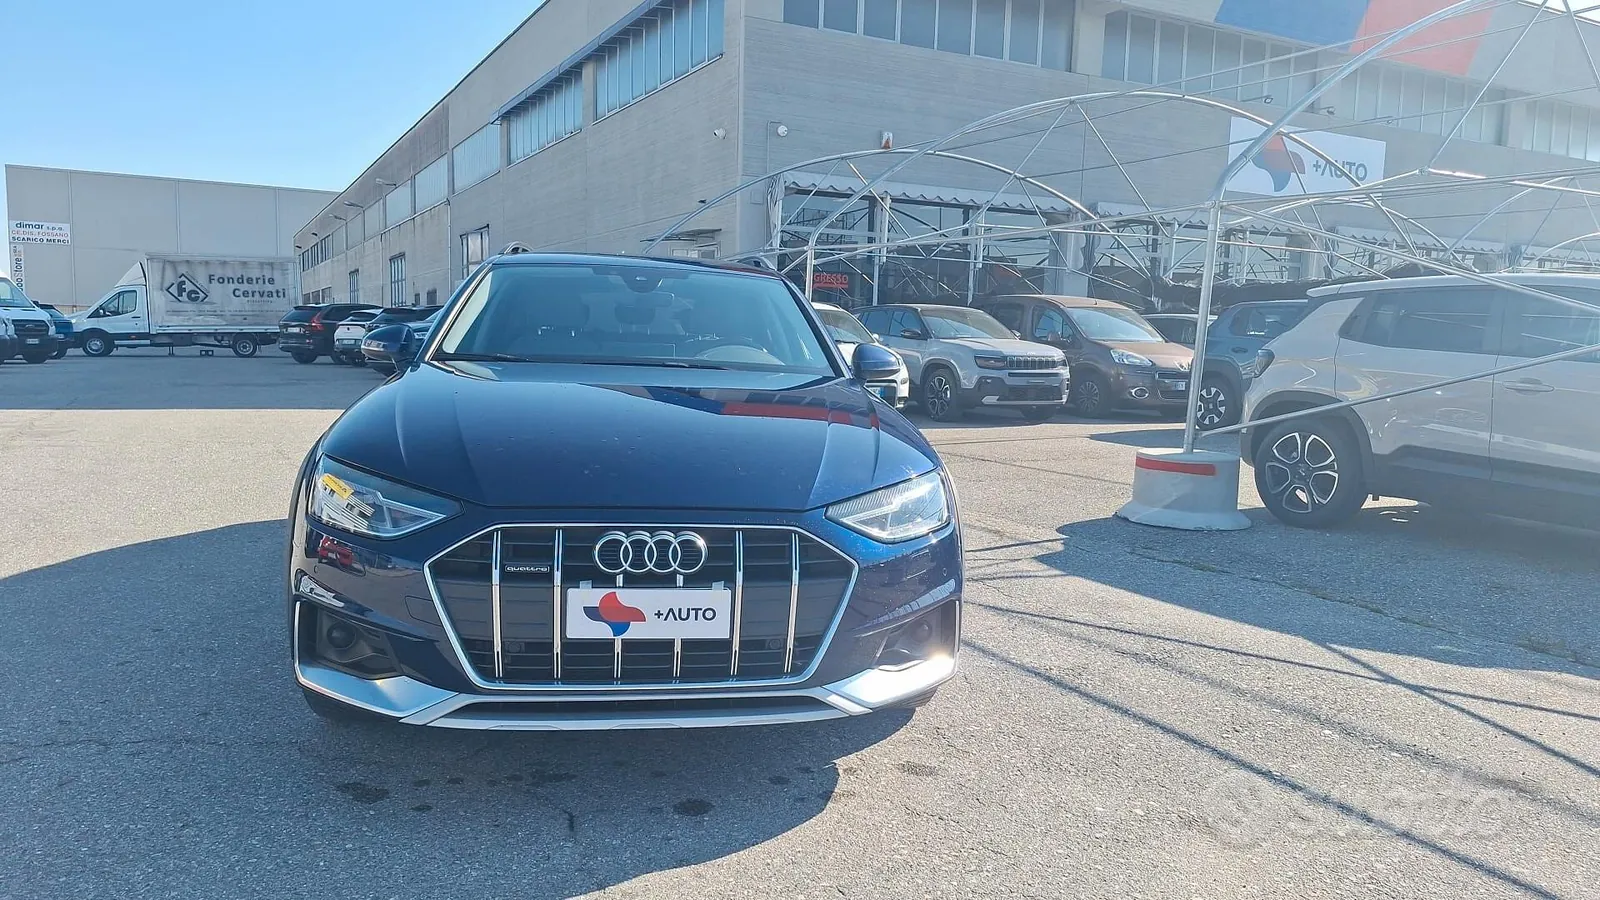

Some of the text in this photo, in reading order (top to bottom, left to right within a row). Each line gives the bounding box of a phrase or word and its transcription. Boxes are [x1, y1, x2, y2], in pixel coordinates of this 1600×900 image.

[15, 222, 45, 230] dimar
[208, 274, 275, 285] Fonderie
[232, 288, 286, 298] Cervati
[654, 607, 717, 622] +AUTO
